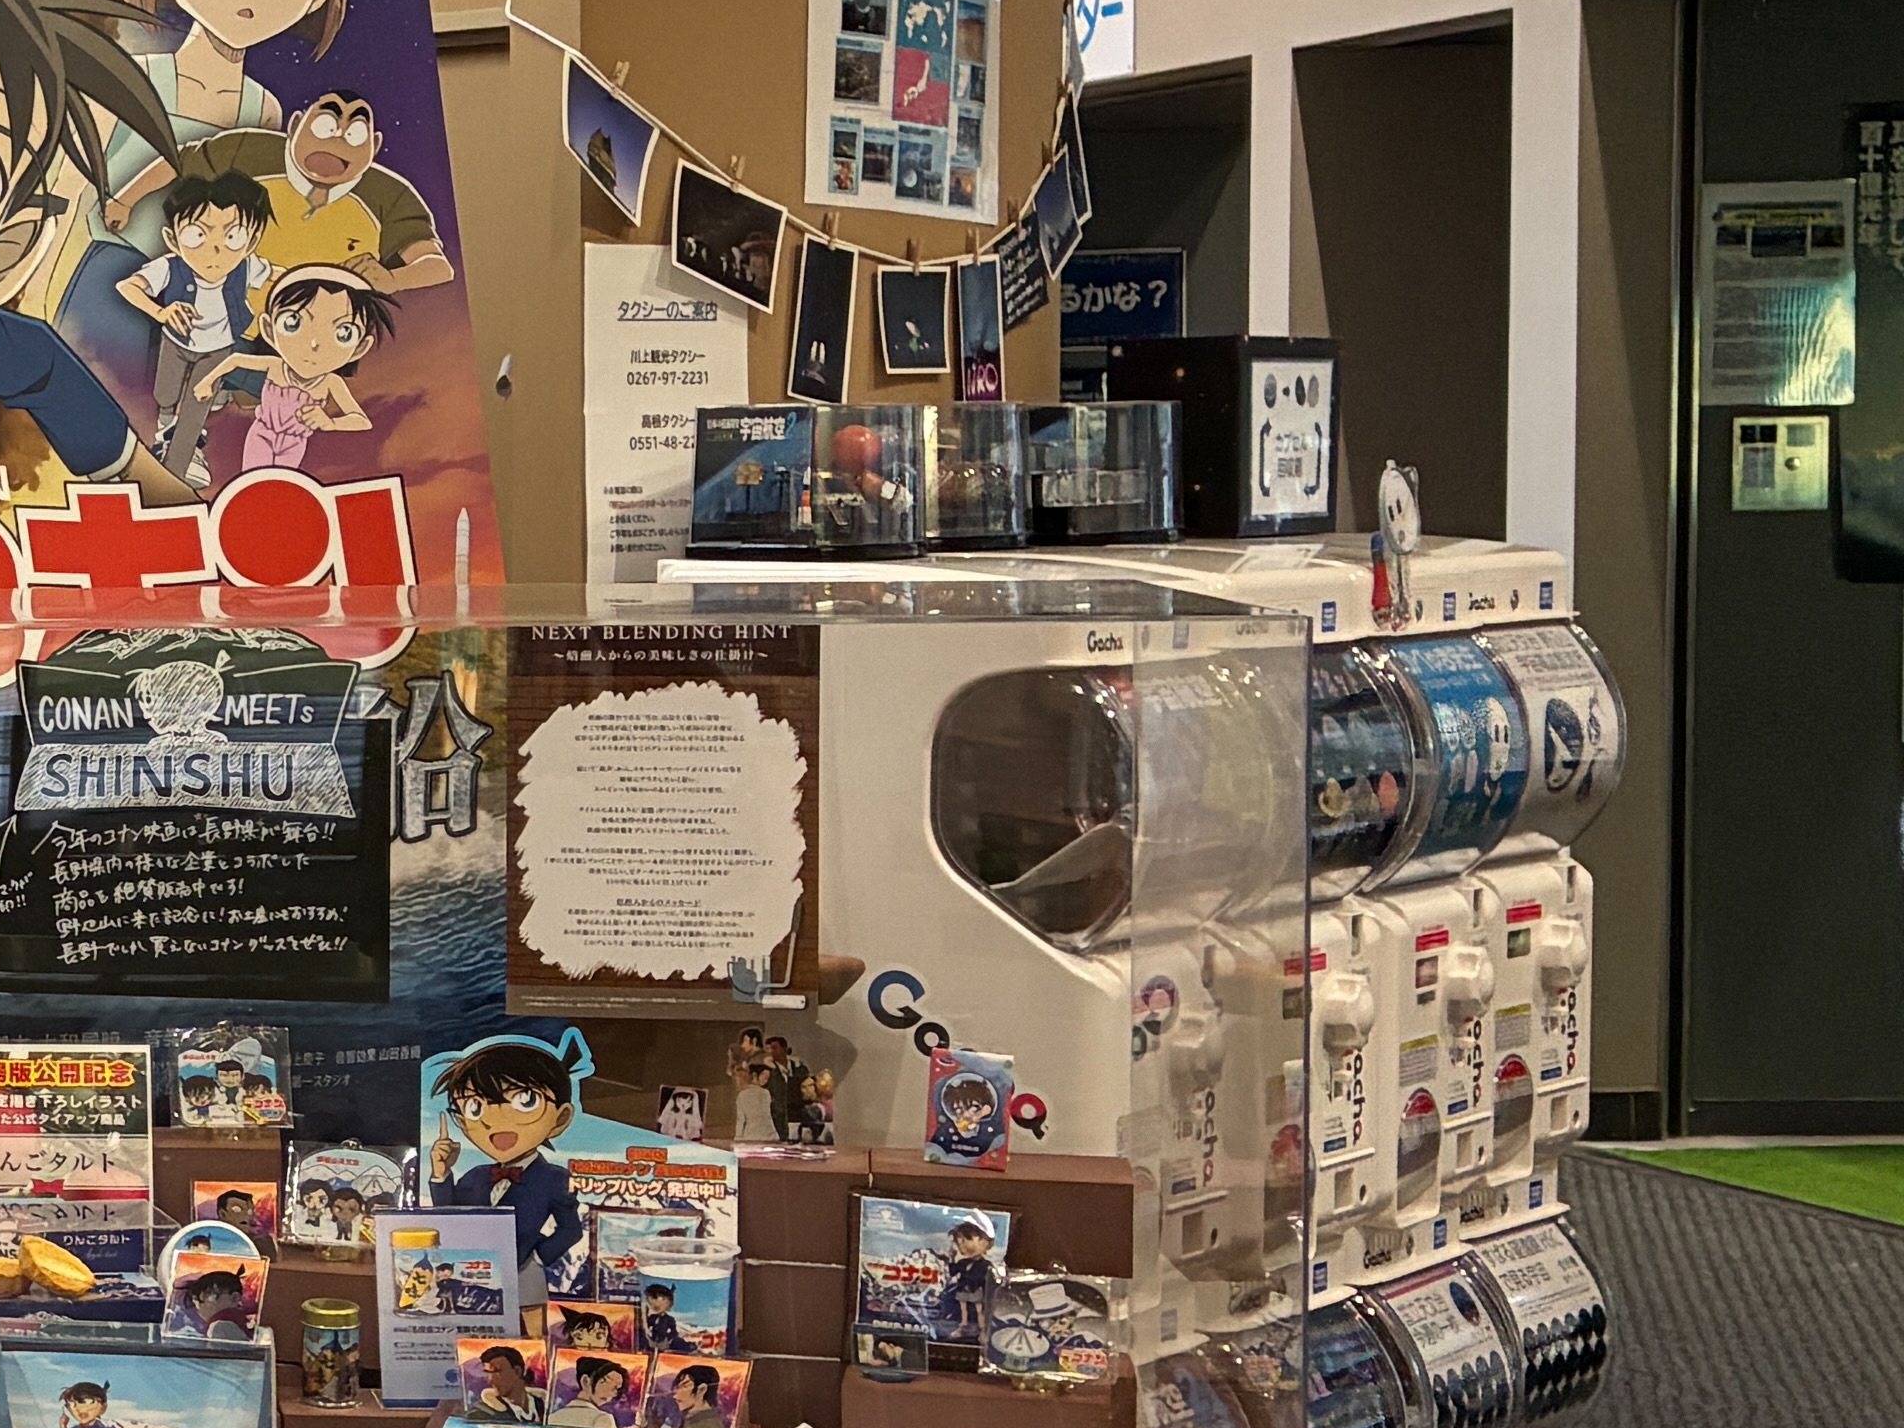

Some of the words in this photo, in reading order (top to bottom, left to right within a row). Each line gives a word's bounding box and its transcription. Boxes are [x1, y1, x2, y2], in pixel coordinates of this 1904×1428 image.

[618, 301, 718, 319] タクシーのご案内
[630, 349, 706, 364] 川上観光タクシー
[626, 371, 709, 385] 0267-97-2231
[532, 625, 592, 641] NEXT
[603, 625, 724, 641] BLENDING
[735, 624, 792, 640] HINT
[1087, 630, 1123, 652] Gacha
[38, 694, 135, 733] CONAN
[41, 752, 294, 803] SHINSHU
[569, 1177, 663, 1196] ドリップバッグ
[667, 1181, 726, 1200] 発売中!!
[882, 1261, 942, 1285] コナン
